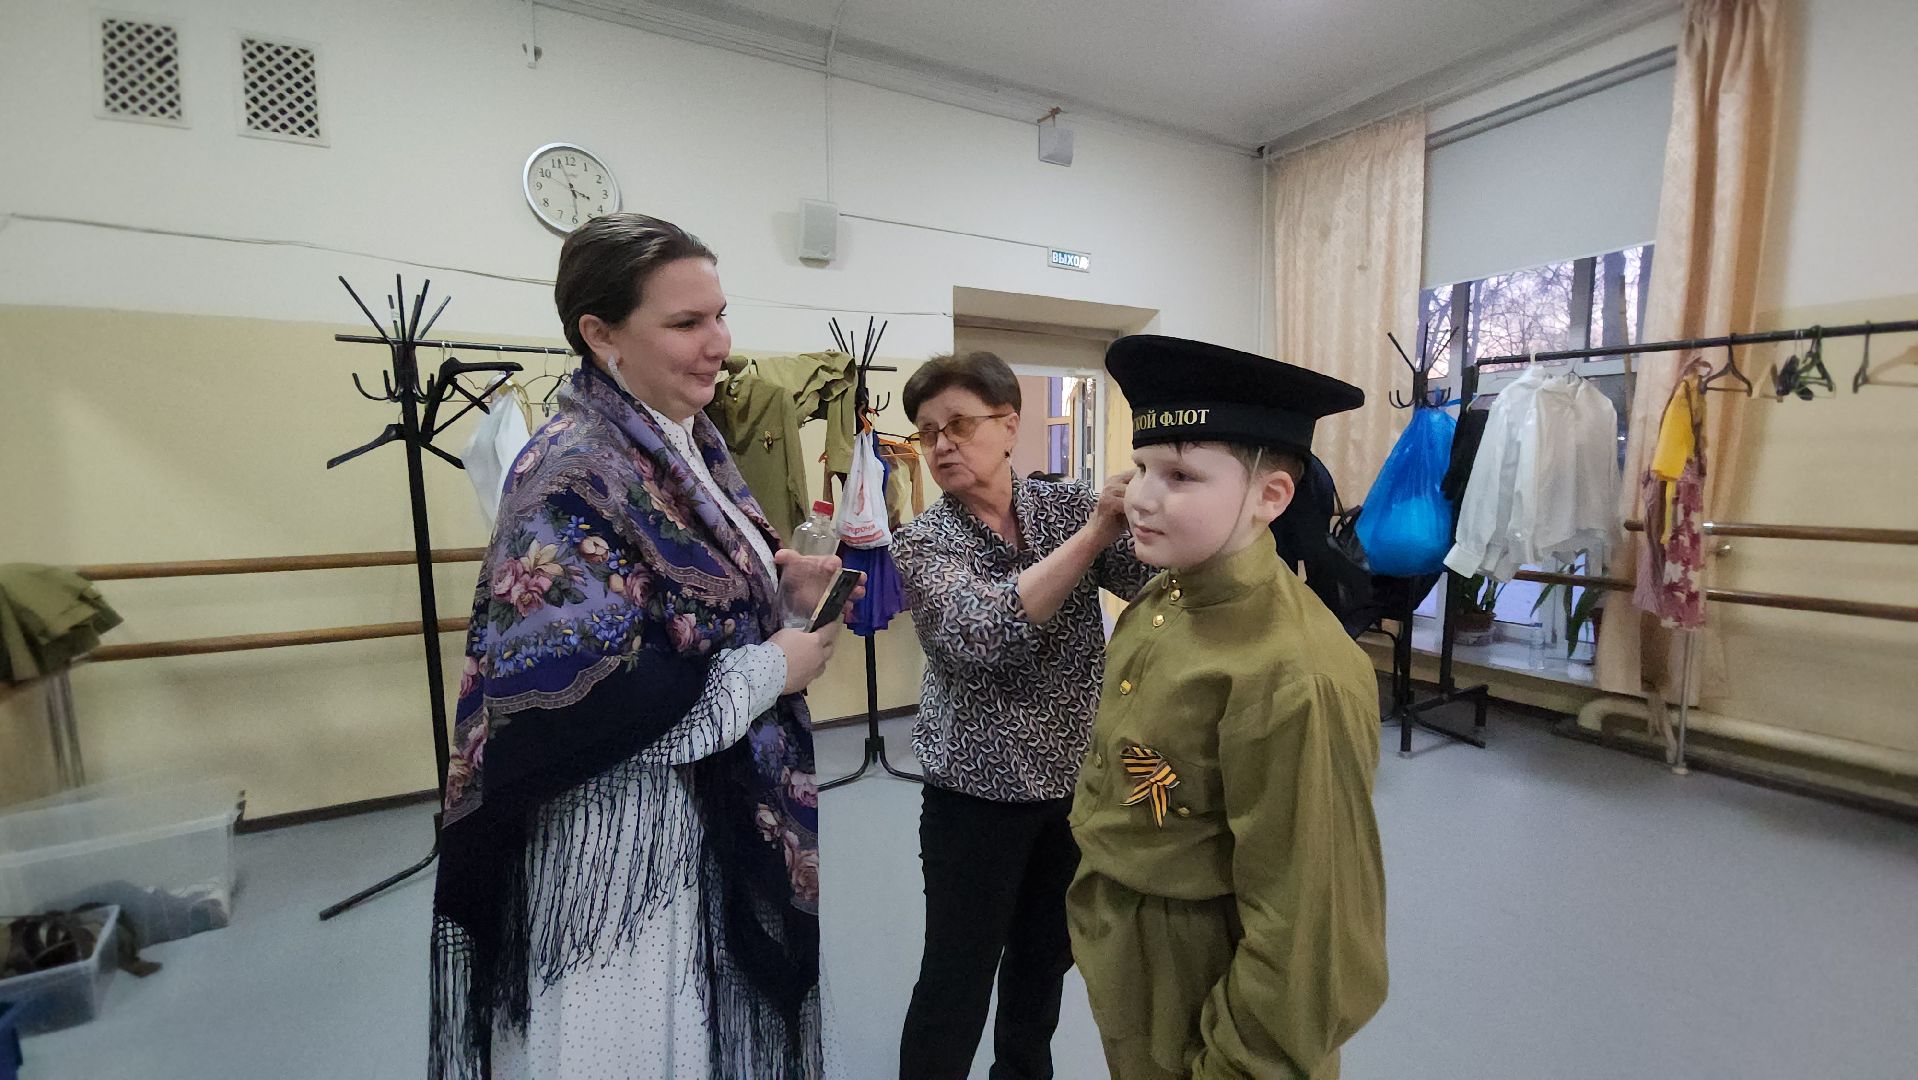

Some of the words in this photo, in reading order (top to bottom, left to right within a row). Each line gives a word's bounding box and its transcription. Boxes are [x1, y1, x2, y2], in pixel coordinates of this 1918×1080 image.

[551, 158, 562, 169] 11
[565, 156, 576, 167] 12
[583, 162, 588, 172] 1
[539, 168, 552, 178] 10
[596, 175, 602, 184] 2
[536, 181, 543, 190] 9
[602, 190, 608, 199] 3
[542, 198, 549, 207] 8
[597, 205, 603, 213] 4
[557, 209, 564, 219] 7
[572, 215, 579, 224] 6
[1134, 410, 1157, 431] КОЙ
[1159, 409, 1210, 427] ФЛОТ
